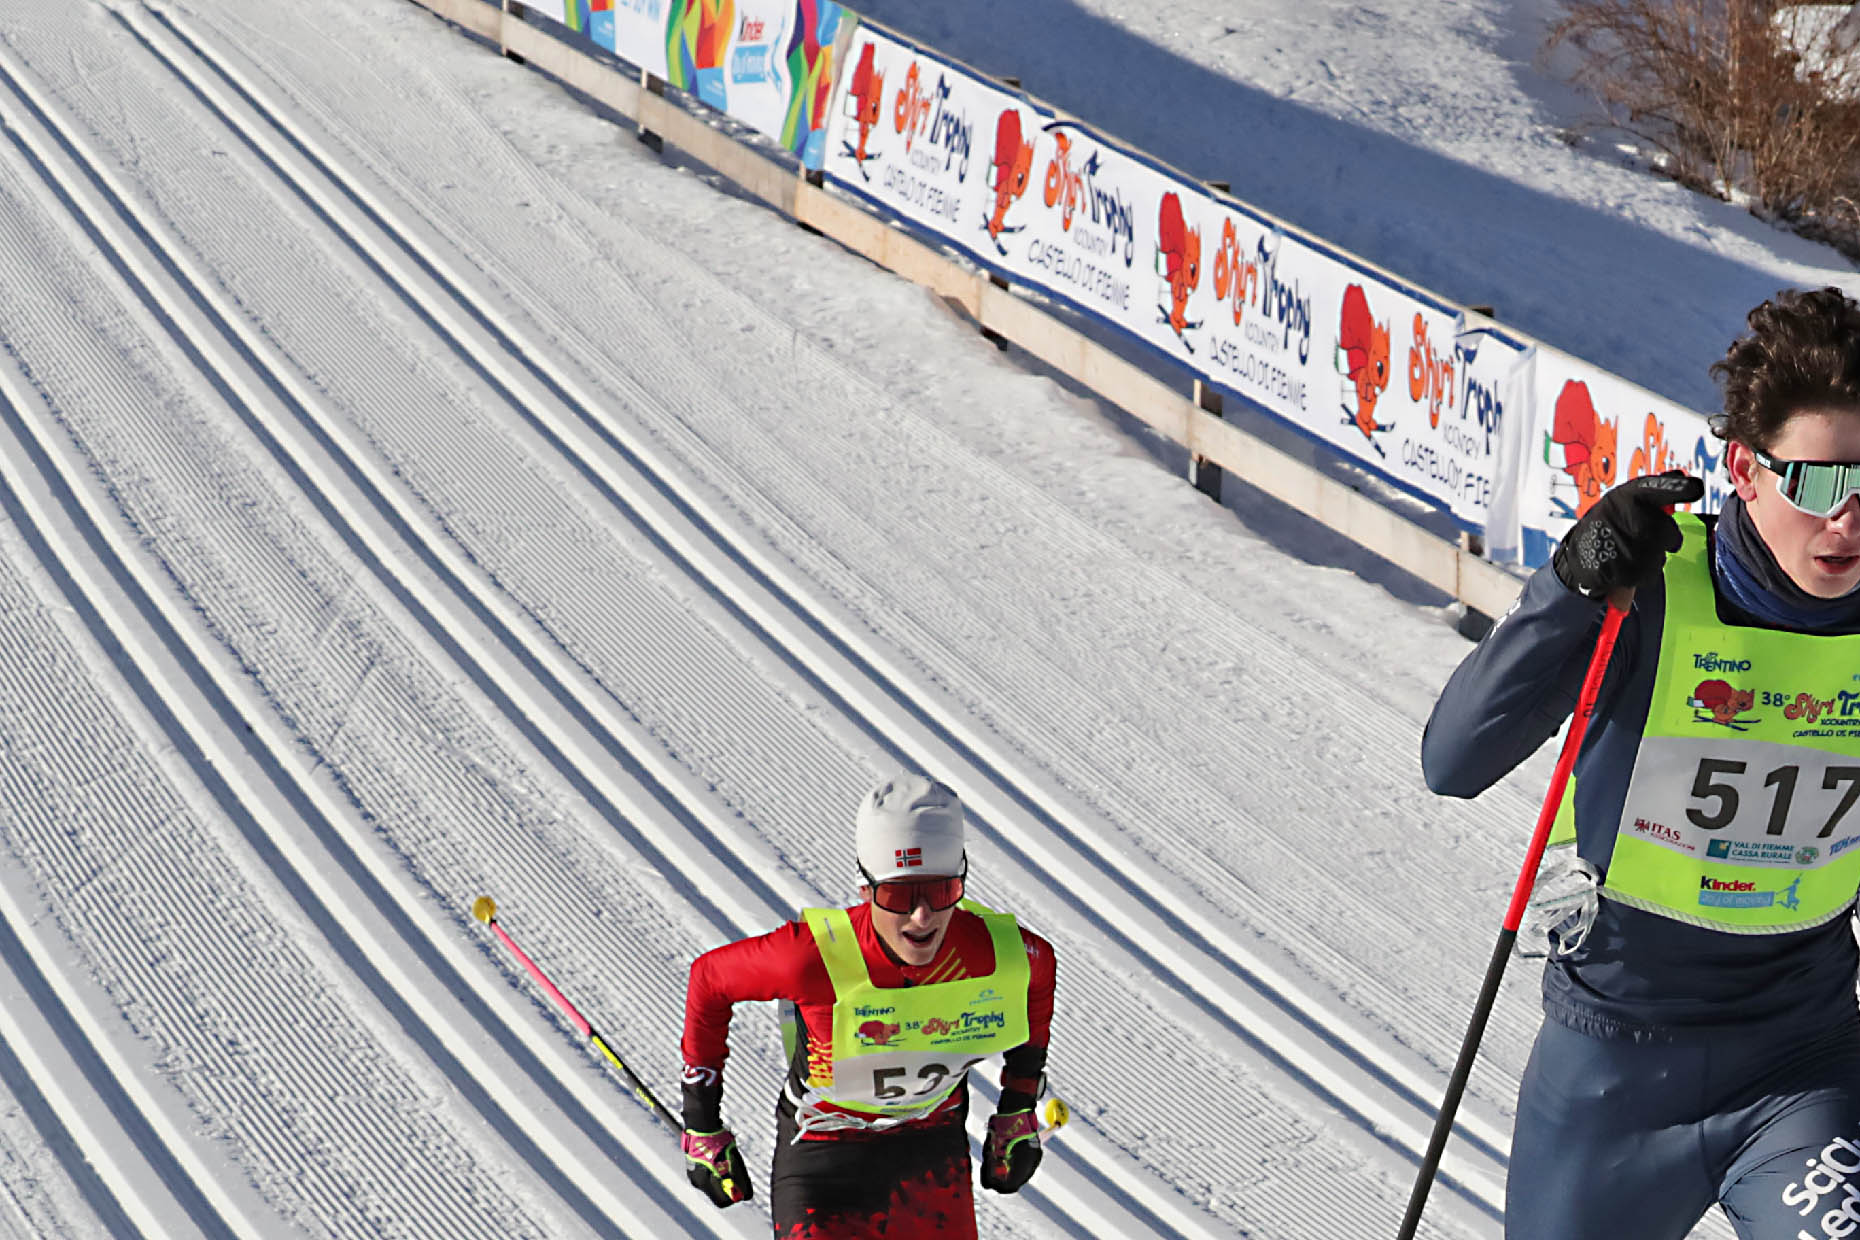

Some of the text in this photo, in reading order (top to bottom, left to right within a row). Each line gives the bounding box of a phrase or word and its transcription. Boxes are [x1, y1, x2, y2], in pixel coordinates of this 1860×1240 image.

[929, 72, 973, 184] Trophy
[1083, 149, 1134, 268] Trophy
[1257, 234, 1311, 366] Trophy
[1454, 341, 1503, 456] Troph
[1693, 653, 1752, 673] TRENTINO
[1651, 823, 1682, 841] ITAS
[1731, 849, 1758, 859] CASSA
[960, 1010, 1005, 1029] Trophy
